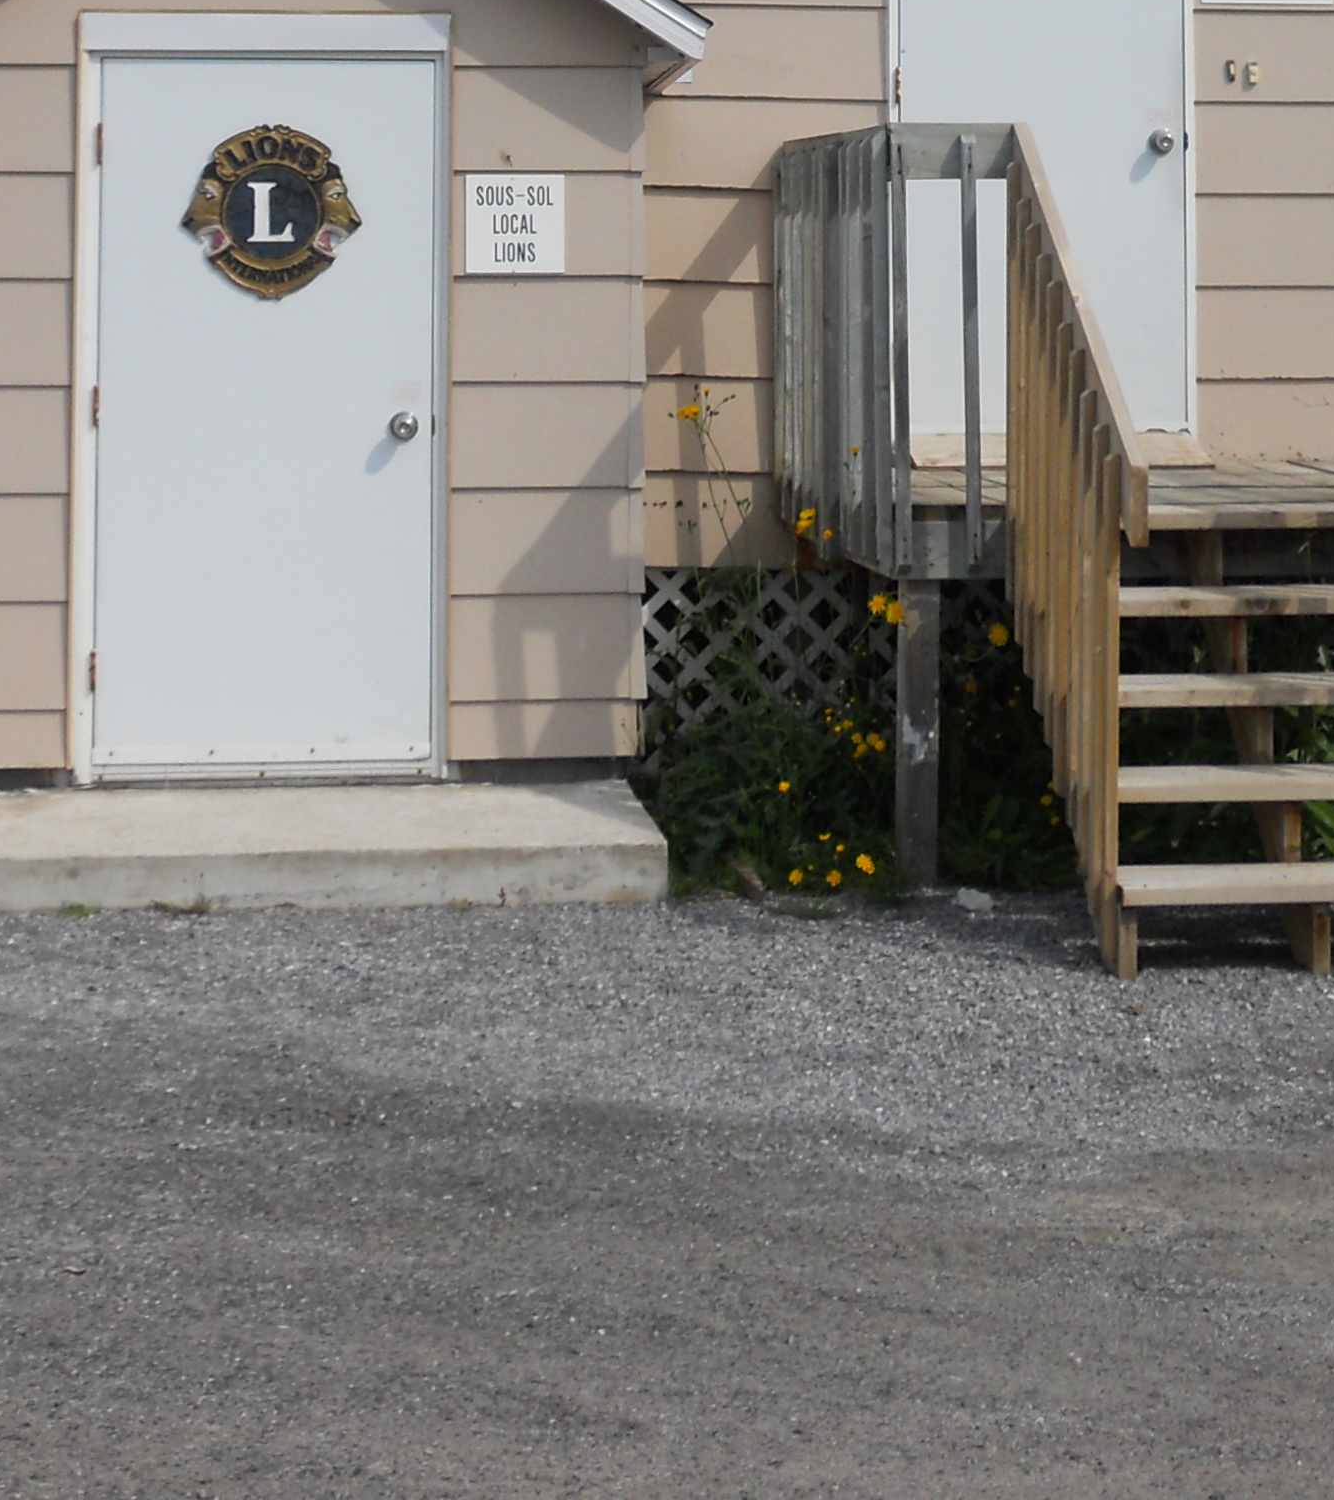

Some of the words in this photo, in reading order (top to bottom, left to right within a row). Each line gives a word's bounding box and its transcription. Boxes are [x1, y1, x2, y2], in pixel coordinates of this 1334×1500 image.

[223, 136, 321, 172] LIONS
[475, 185, 554, 206] SOUS-SOL
[247, 182, 295, 242] L
[492, 213, 537, 234] LOCAL
[494, 242, 536, 263] LIONS
